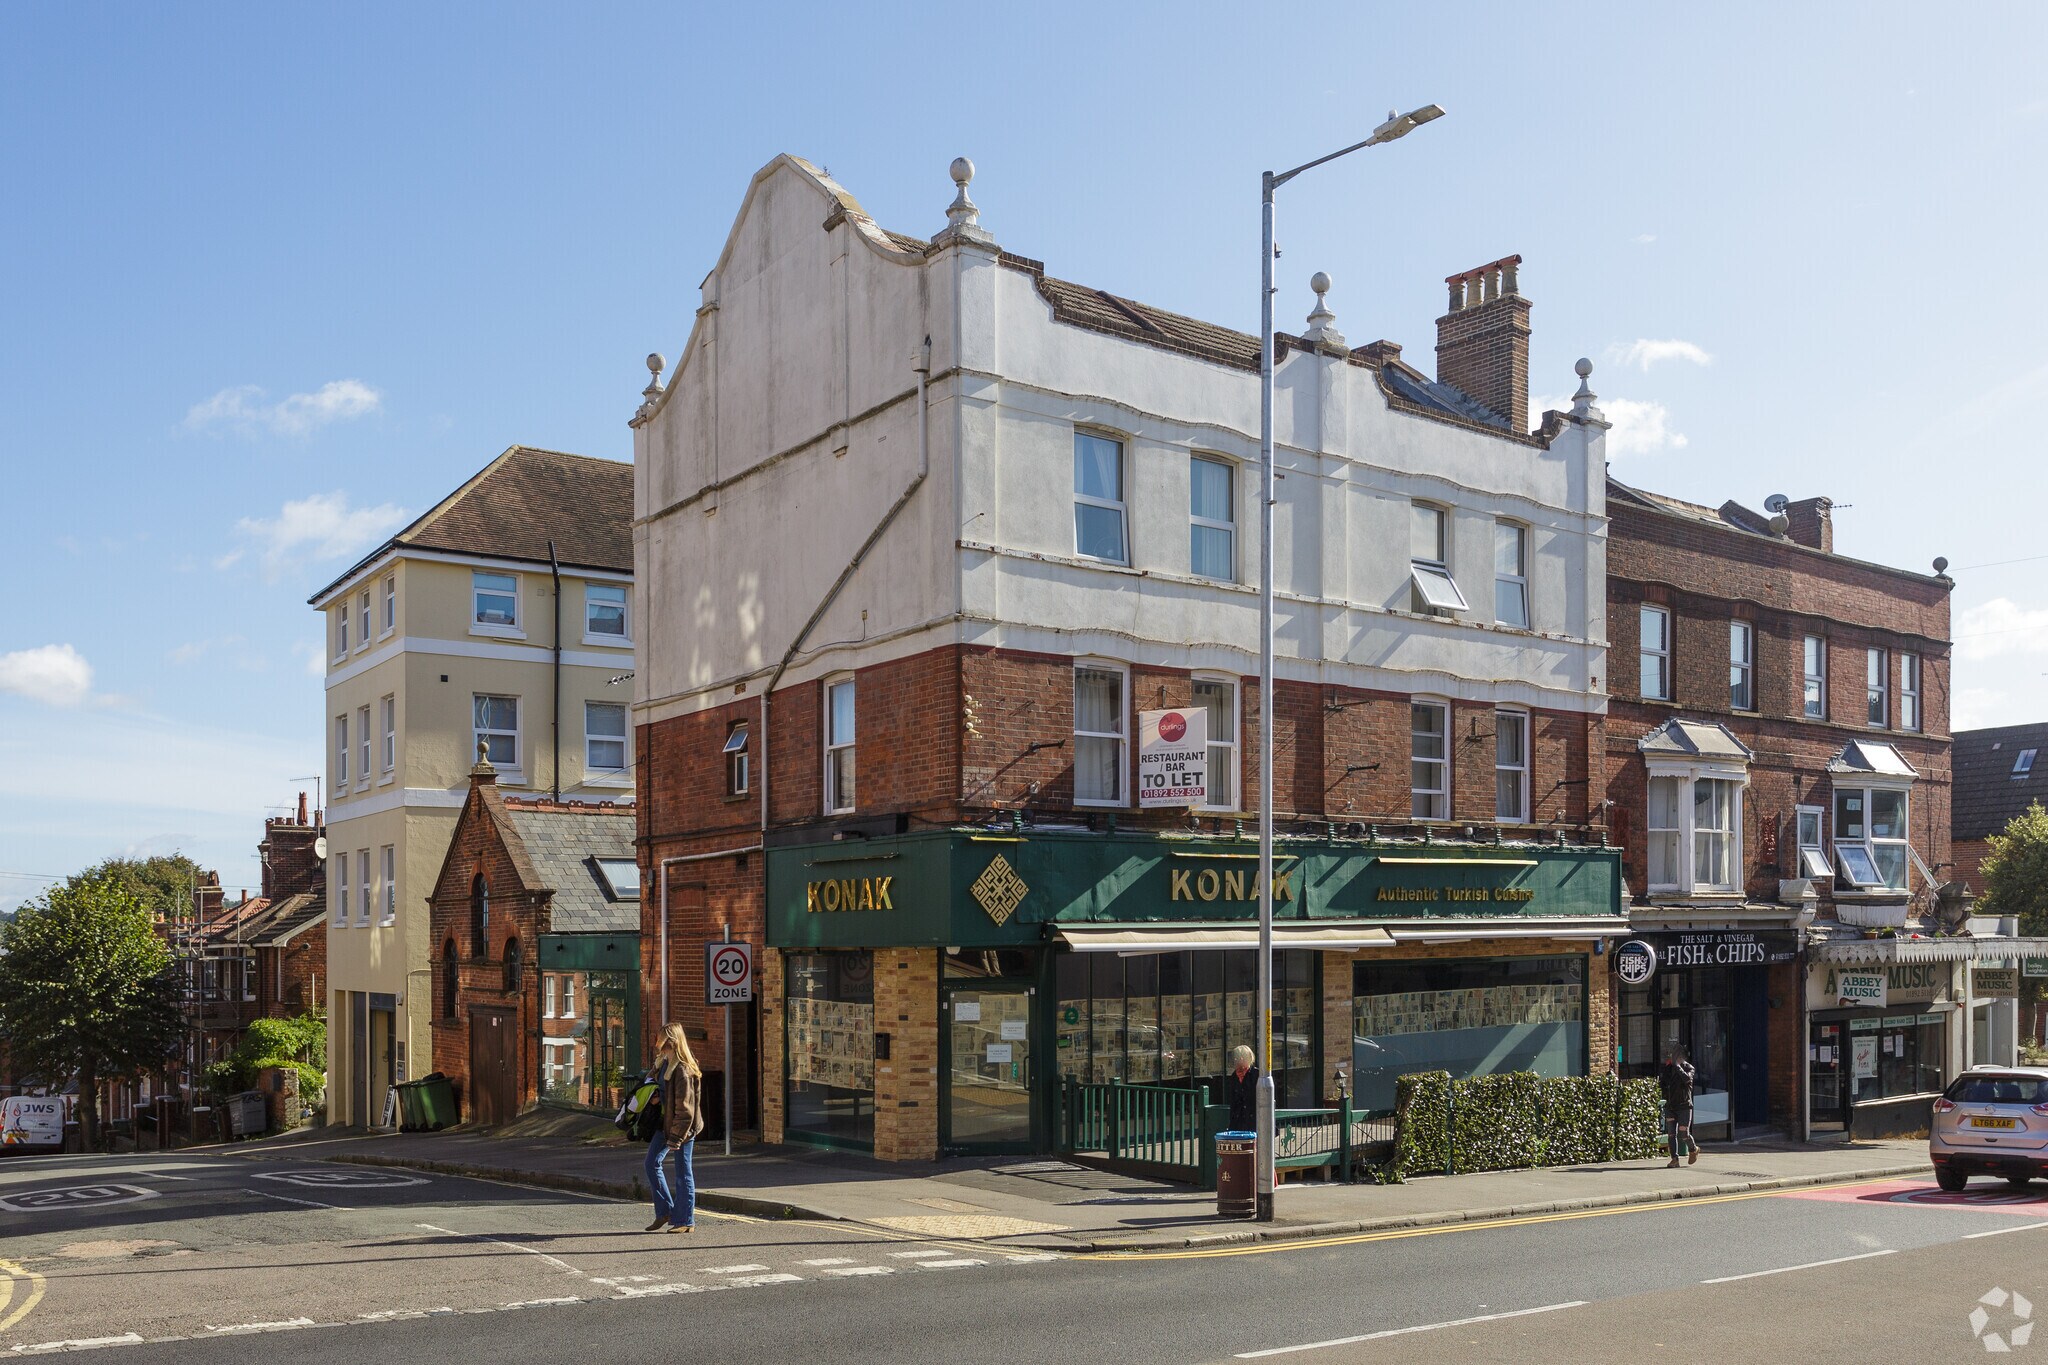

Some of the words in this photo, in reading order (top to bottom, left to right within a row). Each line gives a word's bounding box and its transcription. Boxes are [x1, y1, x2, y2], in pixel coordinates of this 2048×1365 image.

[1160, 723, 1185, 732] durlings
[1141, 751, 1205, 763] RESTAURANT
[1160, 763, 1164, 772] /
[1165, 762, 1185, 772] BAR
[1143, 773, 1166, 788] TO
[1171, 771, 1203, 787] LET
[1144, 788, 1168, 798] 01892
[1170, 788, 1185, 797] 552
[1186, 787, 1202, 796] 500
[807, 876, 893, 912] KONAK
[1377, 885, 1439, 901] Authentic
[1444, 886, 1489, 901] Turkish
[1680, 935, 1695, 944] THE
[1696, 934, 1714, 944] SALT
[1716, 935, 1722, 943] &
[1724, 933, 1755, 943] VINEGAR
[1666, 944, 1706, 965] FISH
[1706, 952, 1714, 964] &
[1716, 942, 1765, 963] CHIPS
[719, 958, 744, 974] 20
[1620, 964, 1647, 973] CHIPS
[1887, 964, 1937, 989] MUSIC
[1976, 971, 2013, 980] ABBEY
[1842, 976, 1882, 987] ABBEY
[1977, 980, 2013, 990] MUSIC
[714, 988, 748, 998] ZONE
[1843, 987, 1881, 997] MUSIC
[24, 1104, 54, 1113] JWS
